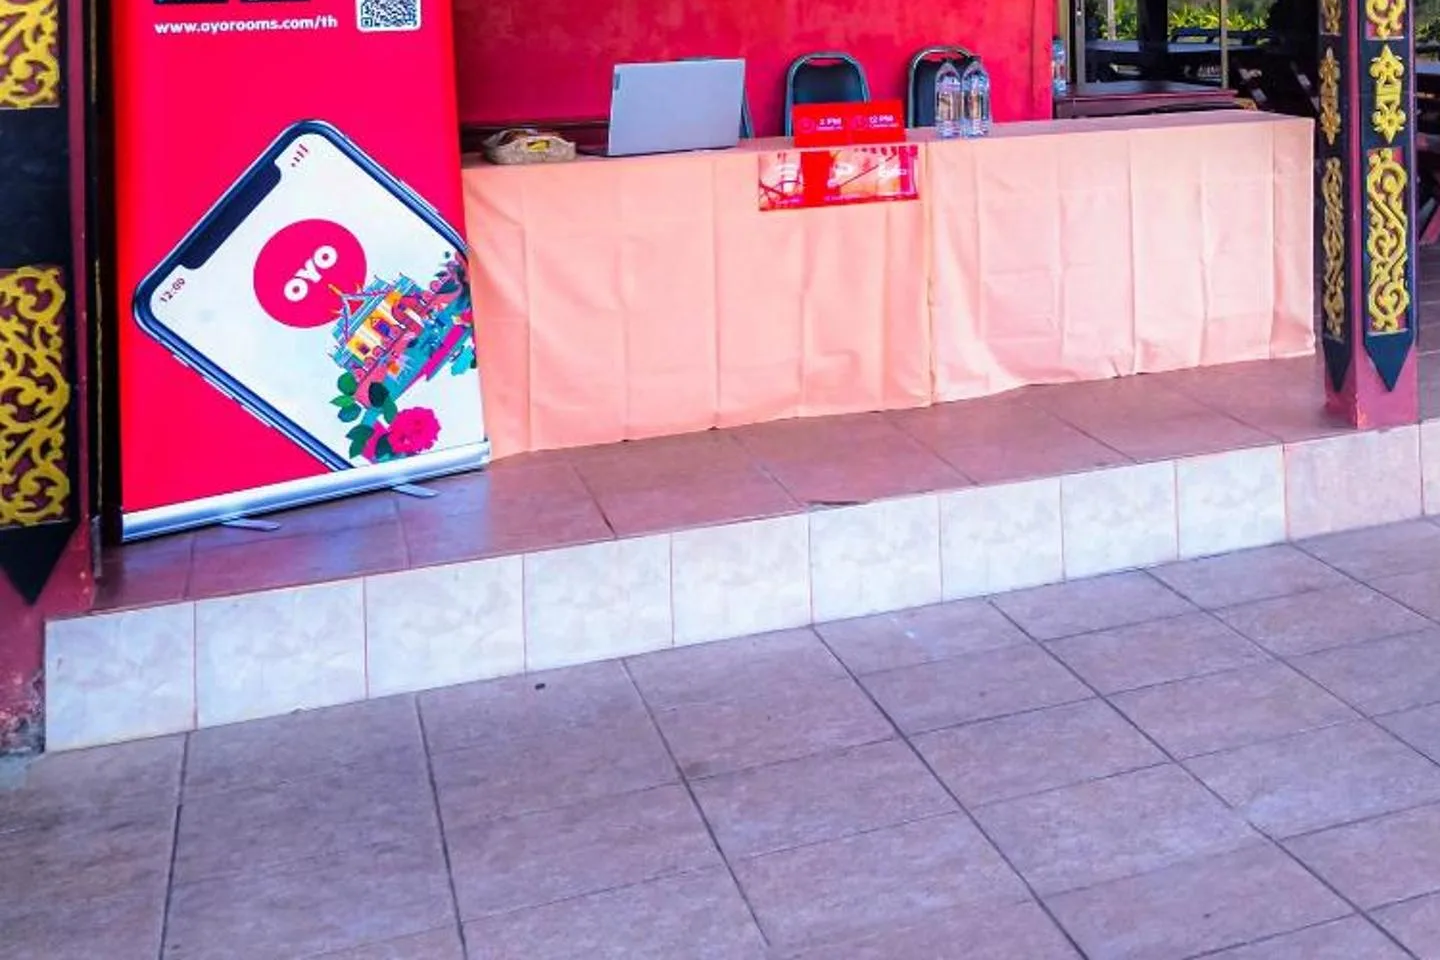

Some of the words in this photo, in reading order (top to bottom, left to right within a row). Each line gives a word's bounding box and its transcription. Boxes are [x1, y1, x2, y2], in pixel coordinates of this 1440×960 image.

[154, 14, 339, 35] www.oyorooms.com/th
[283, 245, 338, 302] OYO
[160, 277, 186, 303] 12:00
